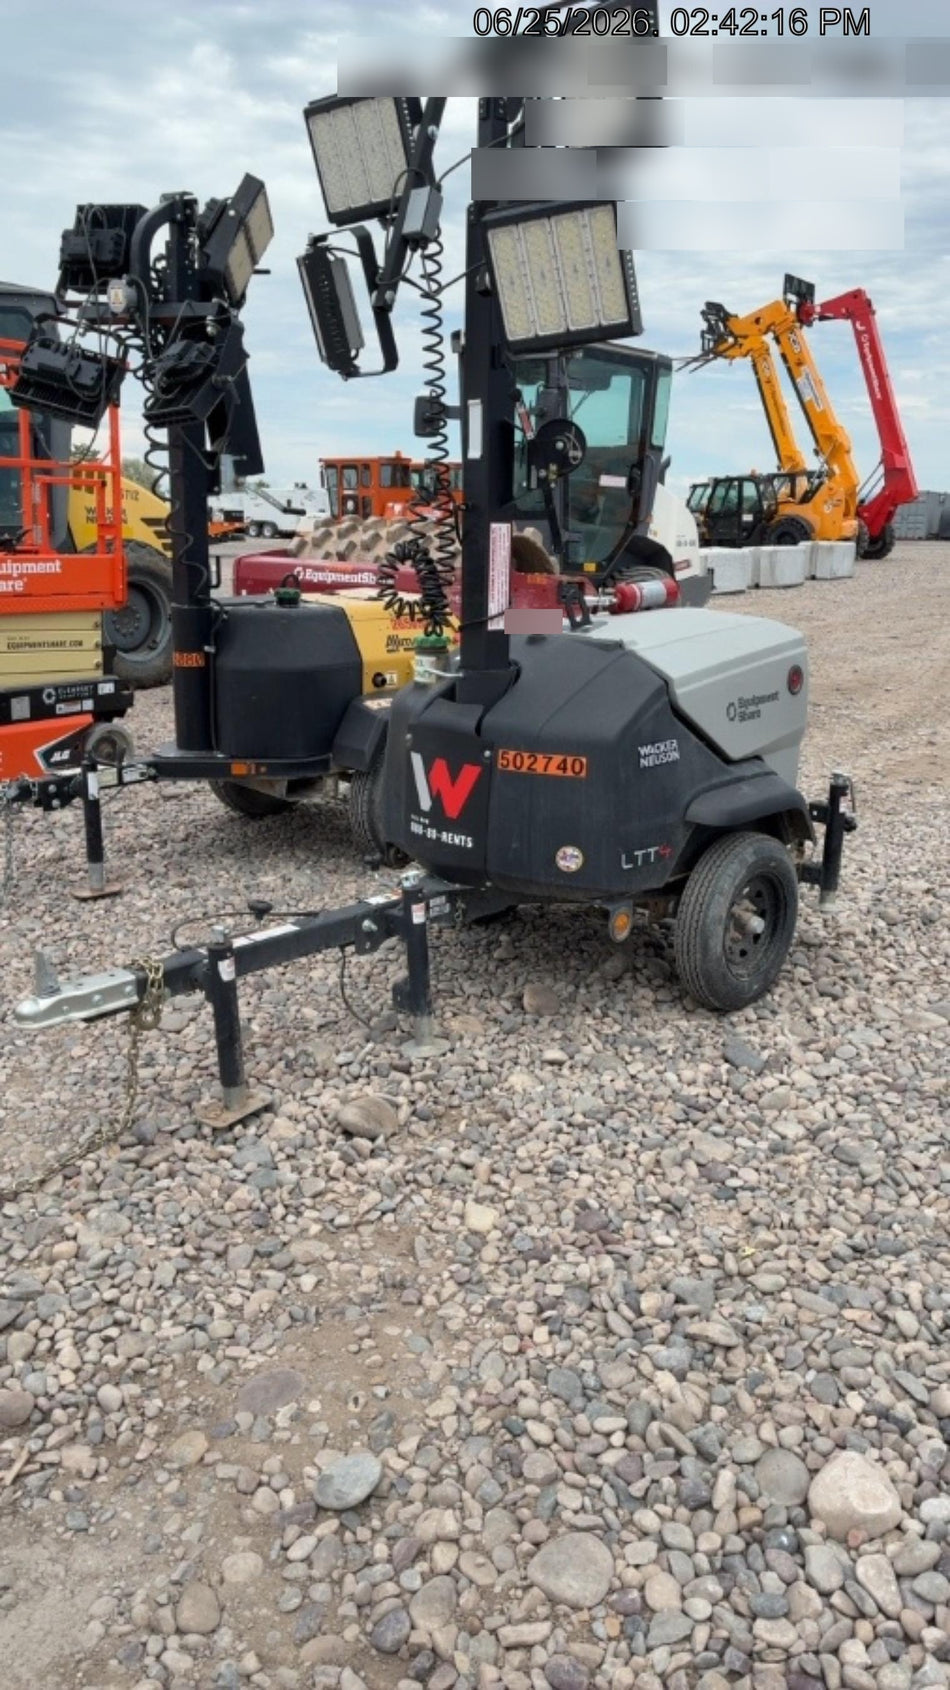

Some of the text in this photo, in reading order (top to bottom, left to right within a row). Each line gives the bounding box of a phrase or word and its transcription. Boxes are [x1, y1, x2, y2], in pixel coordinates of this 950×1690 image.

[737, 691, 780, 710] Equipment
[738, 709, 761, 722] Share
[638, 739, 678, 757] WACKER
[500, 752, 584, 776] 502740
[640, 750, 680, 768] NEUSON
